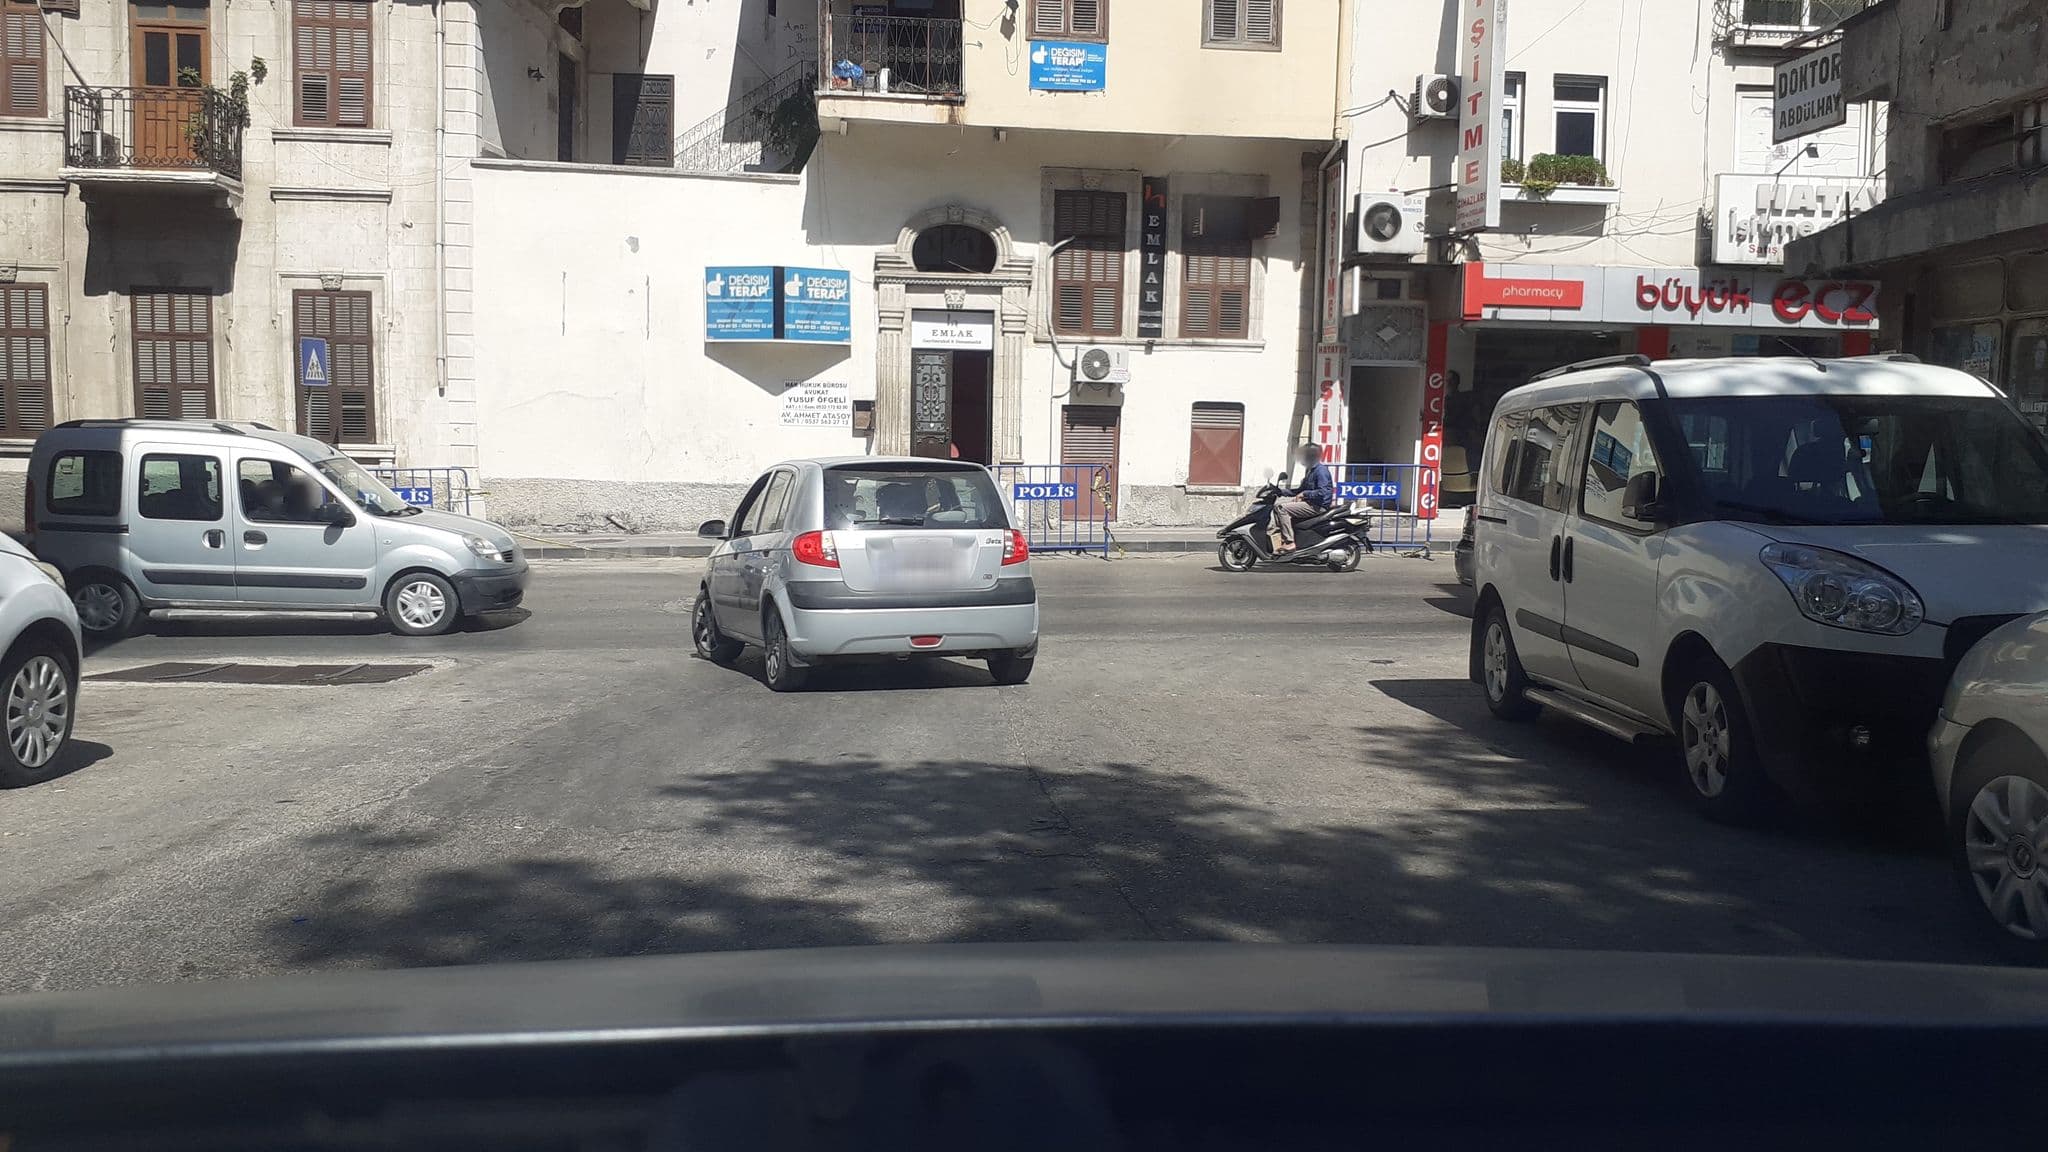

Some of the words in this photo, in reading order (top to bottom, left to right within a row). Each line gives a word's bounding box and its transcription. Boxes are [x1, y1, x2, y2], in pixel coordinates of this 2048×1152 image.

[1464, 0, 1486, 185] ŞİTME
[1778, 53, 1841, 99] DOKTOR
[1778, 91, 1842, 130] ABDÜLHAY
[1756, 183, 1884, 217] HATAY
[1145, 214, 1161, 303] EMLAK
[1502, 285, 1563, 300] pharmacy
[1636, 275, 1752, 320] büyük
[931, 329, 973, 338] EMLAK
[822, 412, 851, 420] ATASOY
[1420, 372, 1444, 510] eczane
[364, 487, 430, 505] PLİS
[1018, 484, 1074, 498] POLİS
[1340, 482, 1398, 497] POLİS
